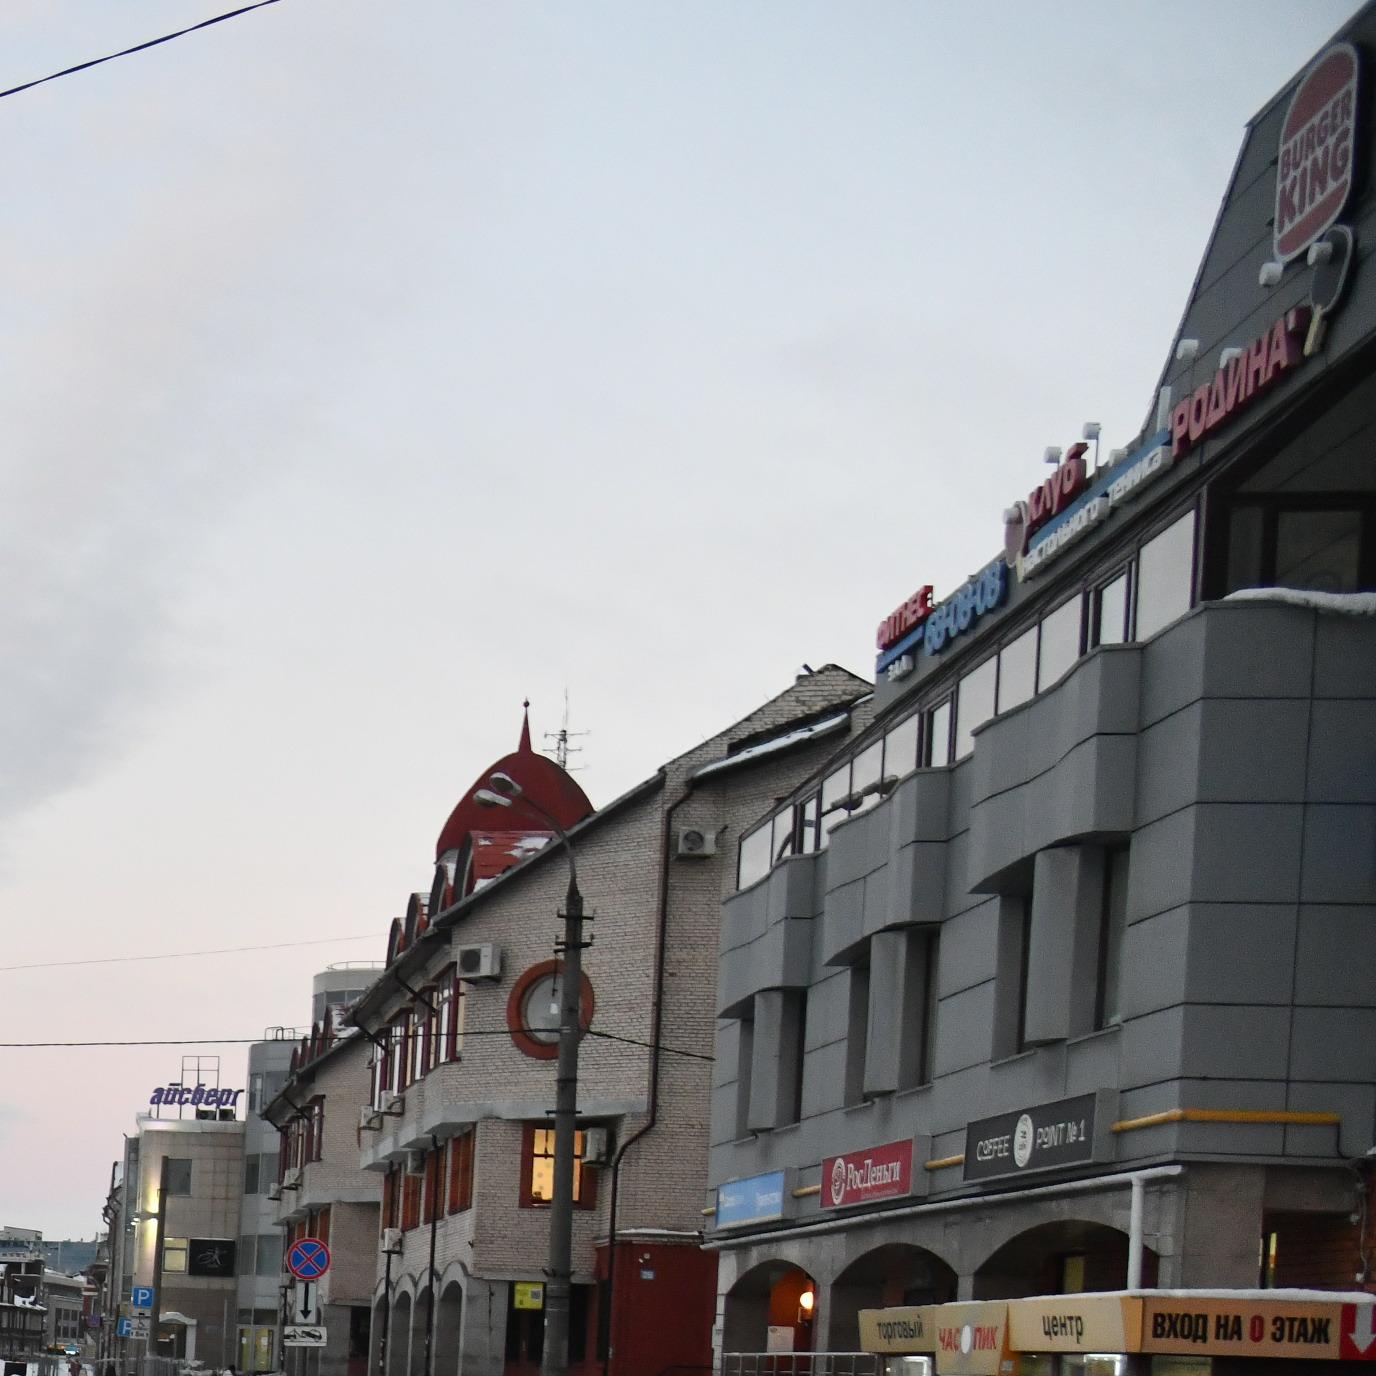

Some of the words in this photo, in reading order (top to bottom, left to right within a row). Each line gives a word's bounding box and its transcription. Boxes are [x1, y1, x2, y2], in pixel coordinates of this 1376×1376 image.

[1280, 86, 1353, 184] BURGER
[1278, 126, 1352, 236] KING
[976, 1134, 1010, 1161] COFFEE
[846, 1158, 901, 1191] РосДеньги
[137, 1289, 150, 1305] P
[876, 1314, 925, 1347] торговый
[938, 1328, 961, 1352] ЧАС
[971, 1326, 998, 1351] ПИК
[1042, 1314, 1084, 1345] центр
[1152, 1312, 1208, 1344] ВХОД
[1214, 1314, 1243, 1342] НА
[1271, 1316, 1332, 1344] ЭТАЖ
